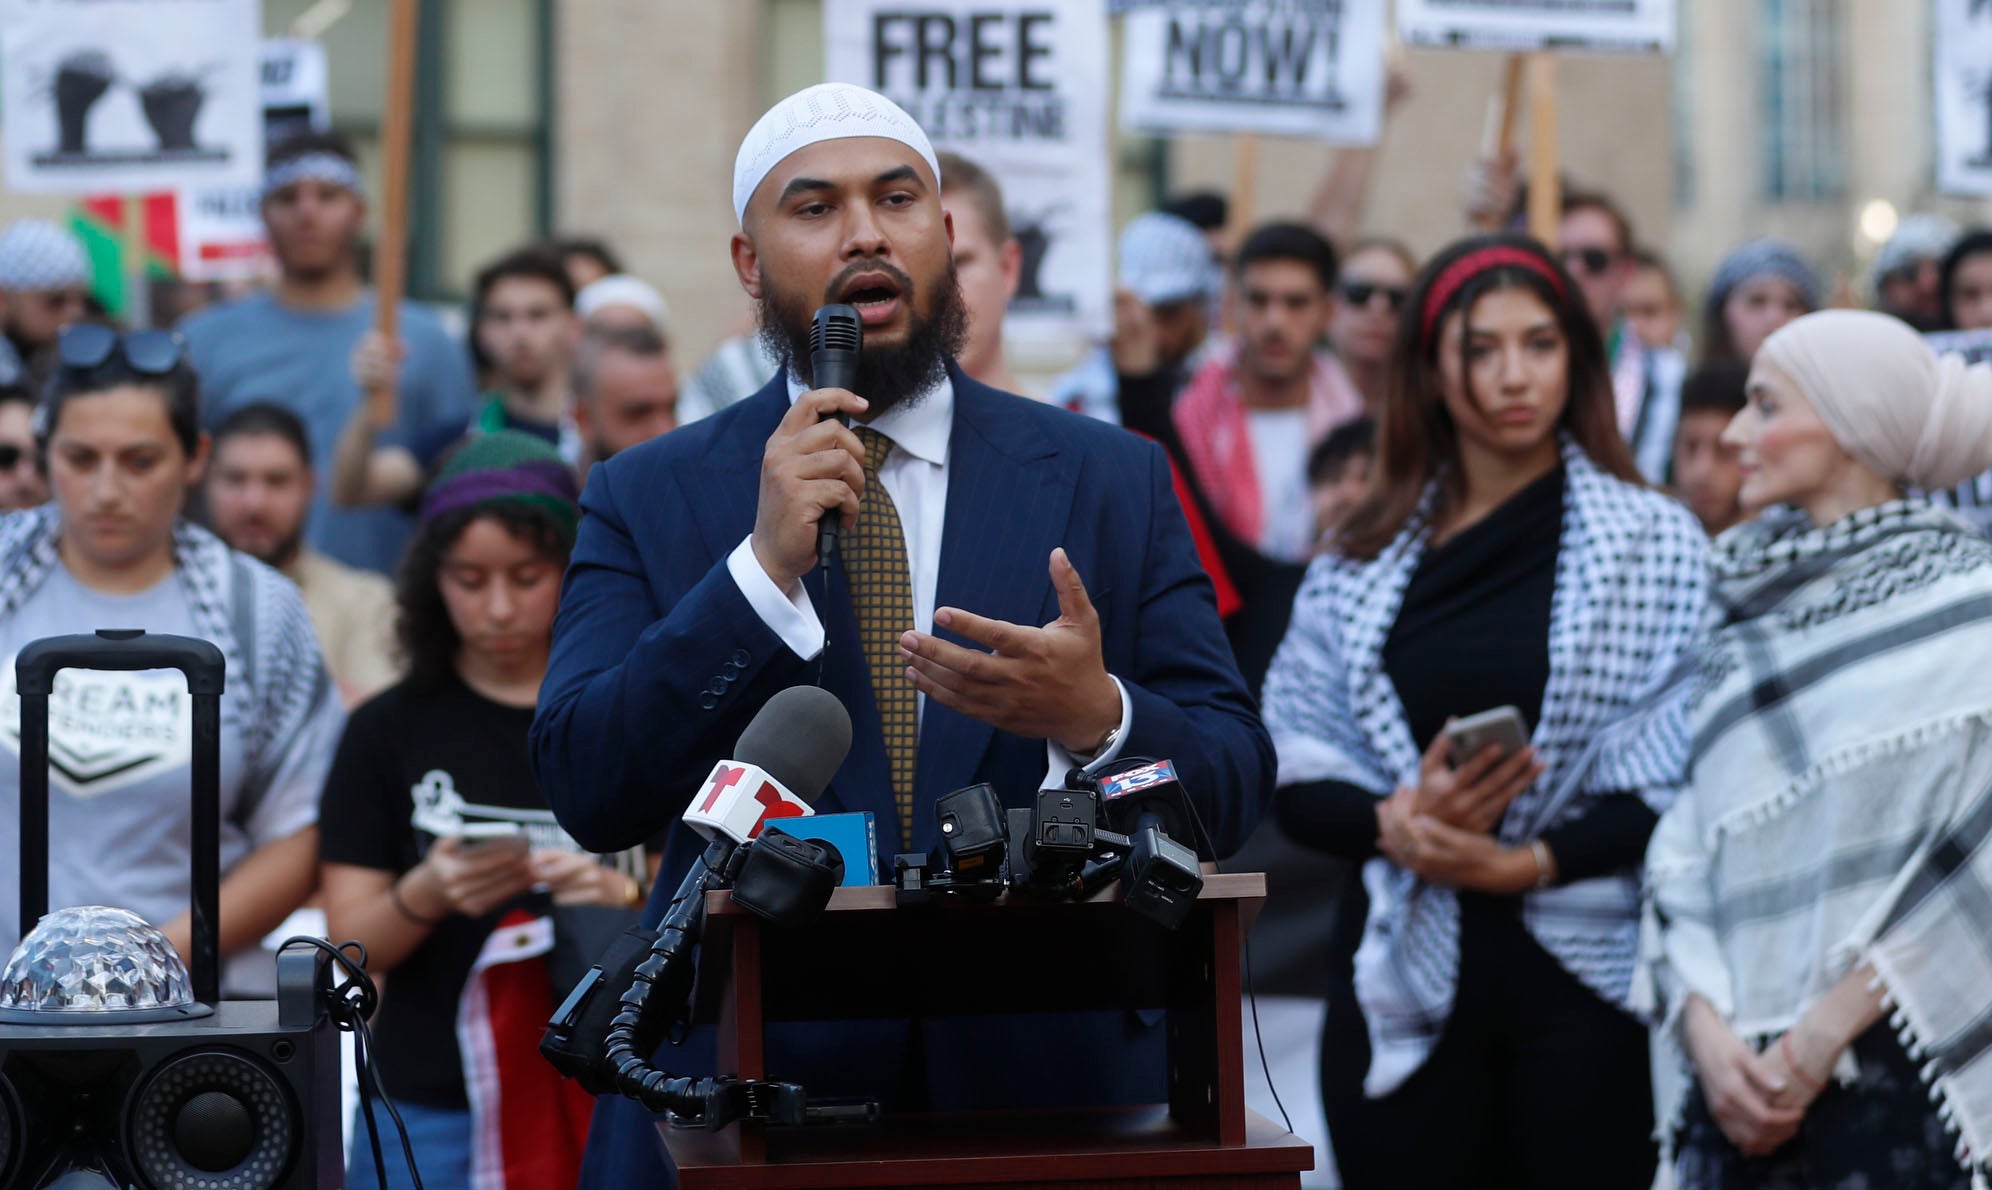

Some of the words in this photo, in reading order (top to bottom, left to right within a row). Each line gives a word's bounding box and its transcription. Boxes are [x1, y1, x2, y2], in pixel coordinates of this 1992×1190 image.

[874, 15, 1054, 89] FREE
[1165, 18, 1341, 96] NOW!
[54, 677, 181, 716] REAM
[1111, 763, 1161, 782] FOX
[1116, 770, 1160, 790] 13
